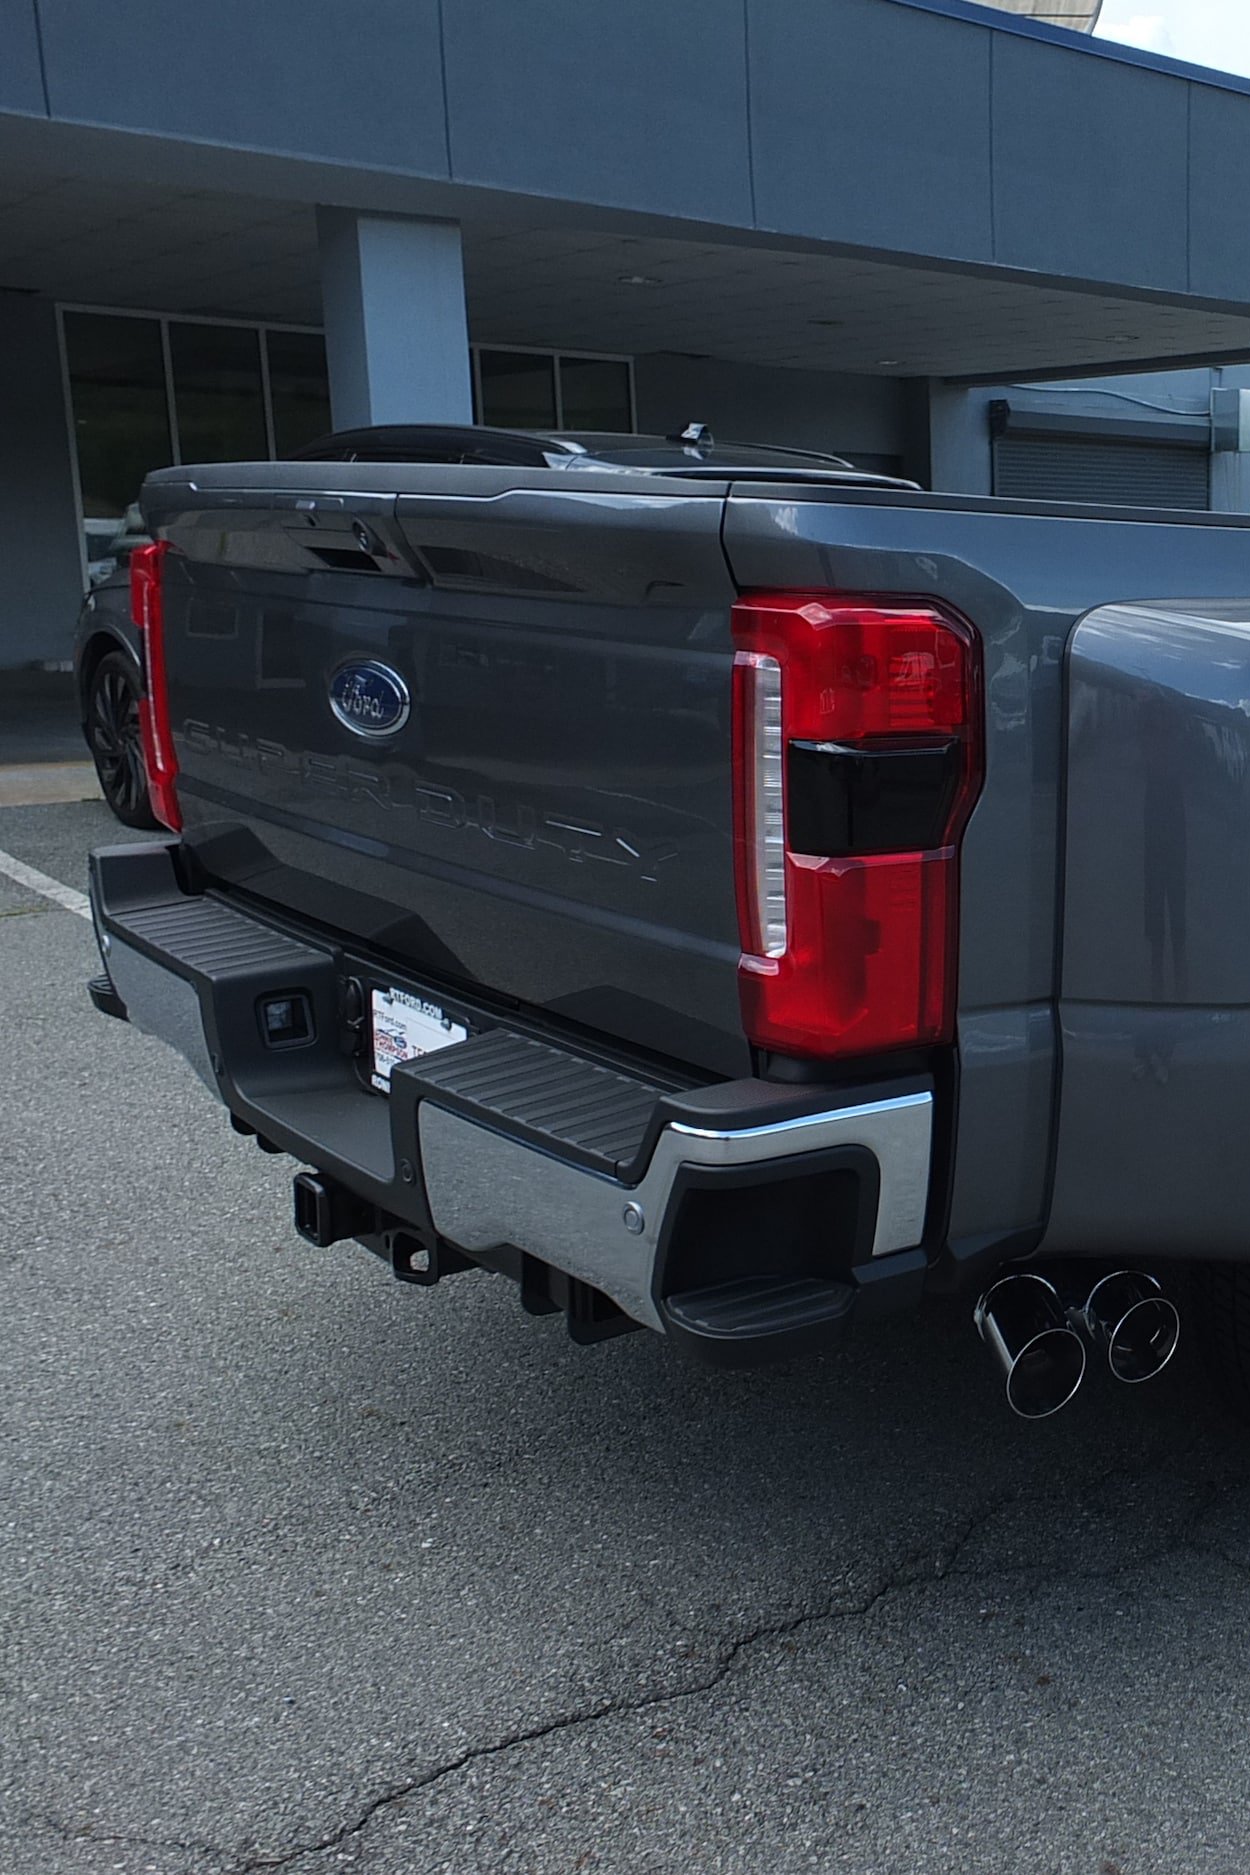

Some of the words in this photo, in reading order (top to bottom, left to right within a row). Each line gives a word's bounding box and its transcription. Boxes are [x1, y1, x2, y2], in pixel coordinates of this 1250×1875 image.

[341, 672, 385, 718] Ford
[183, 718, 392, 810] SUPER
[414, 779, 679, 882] DUTY
